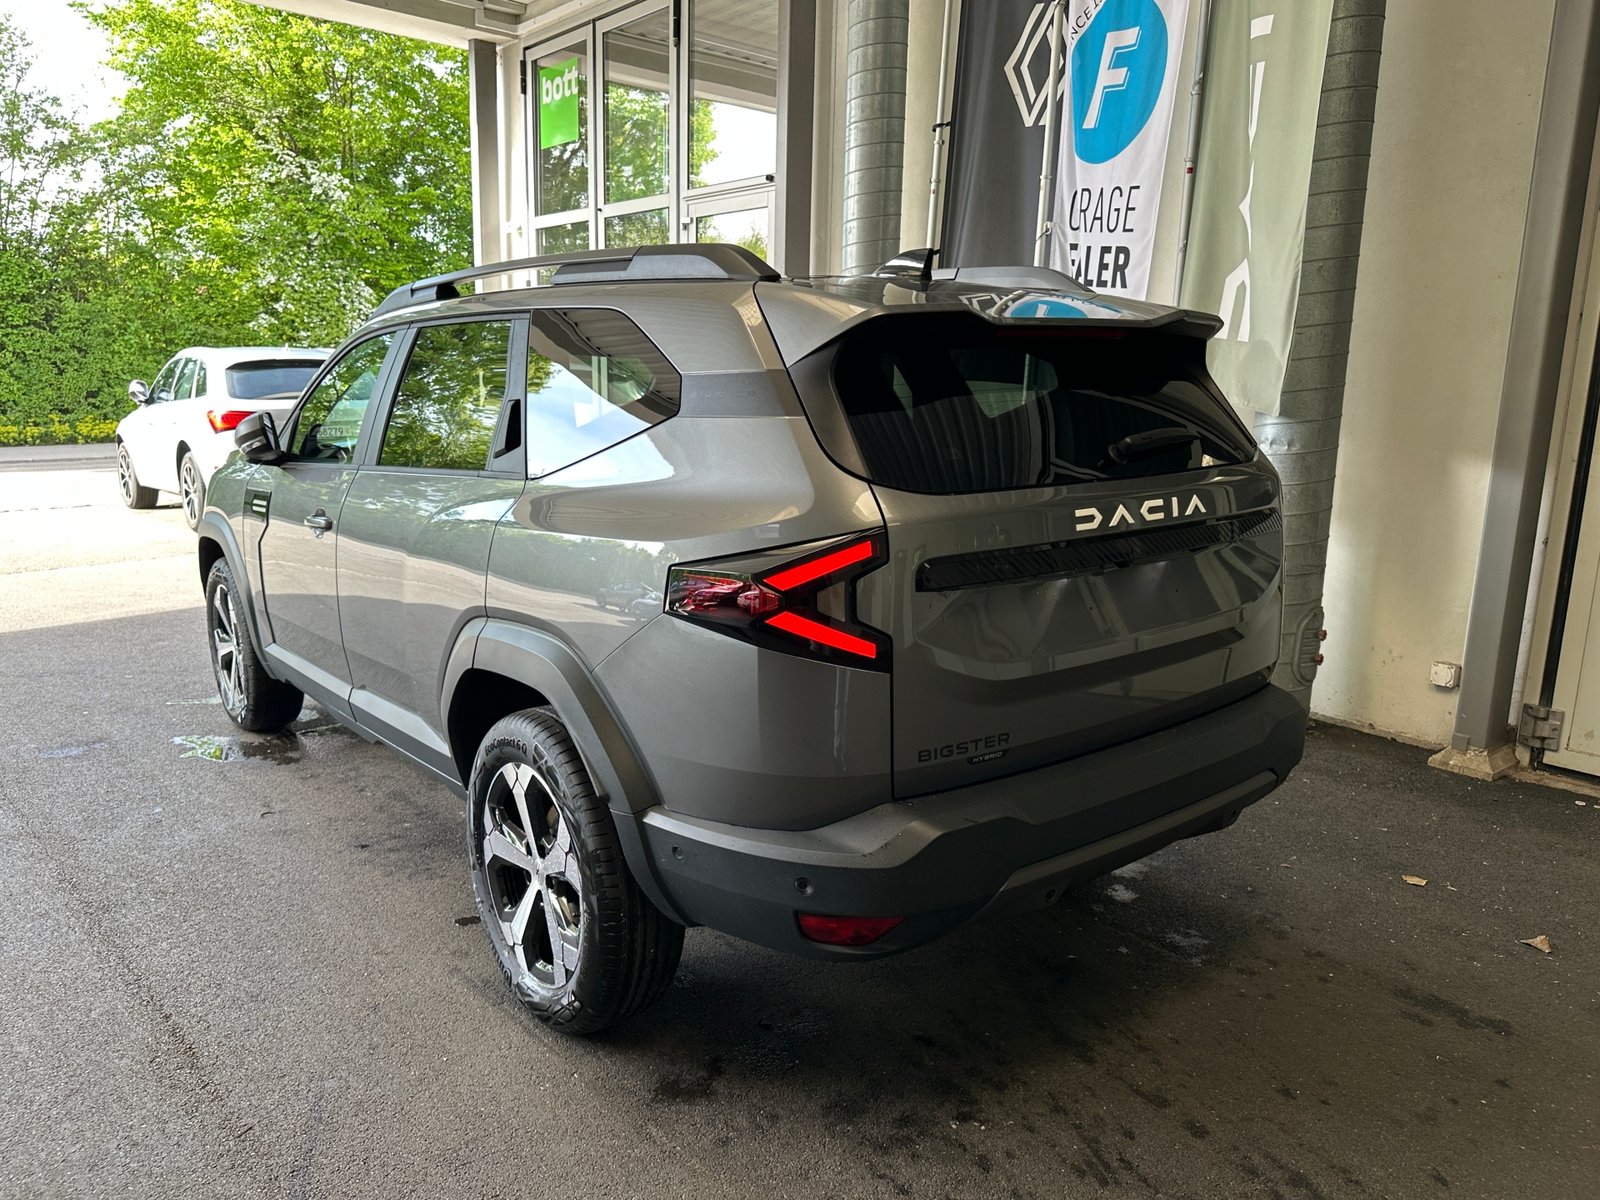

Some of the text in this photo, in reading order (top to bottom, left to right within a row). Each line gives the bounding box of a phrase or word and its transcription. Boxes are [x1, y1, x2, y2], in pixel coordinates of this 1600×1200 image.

[542, 65, 578, 104] bott
[1082, 26, 1142, 128] F
[1075, 494, 1207, 532] DACIA
[484, 736, 528, 757] EcoContact 6 Q
[918, 732, 1010, 762] BIGSTER
[972, 751, 1004, 764] HYBRID
